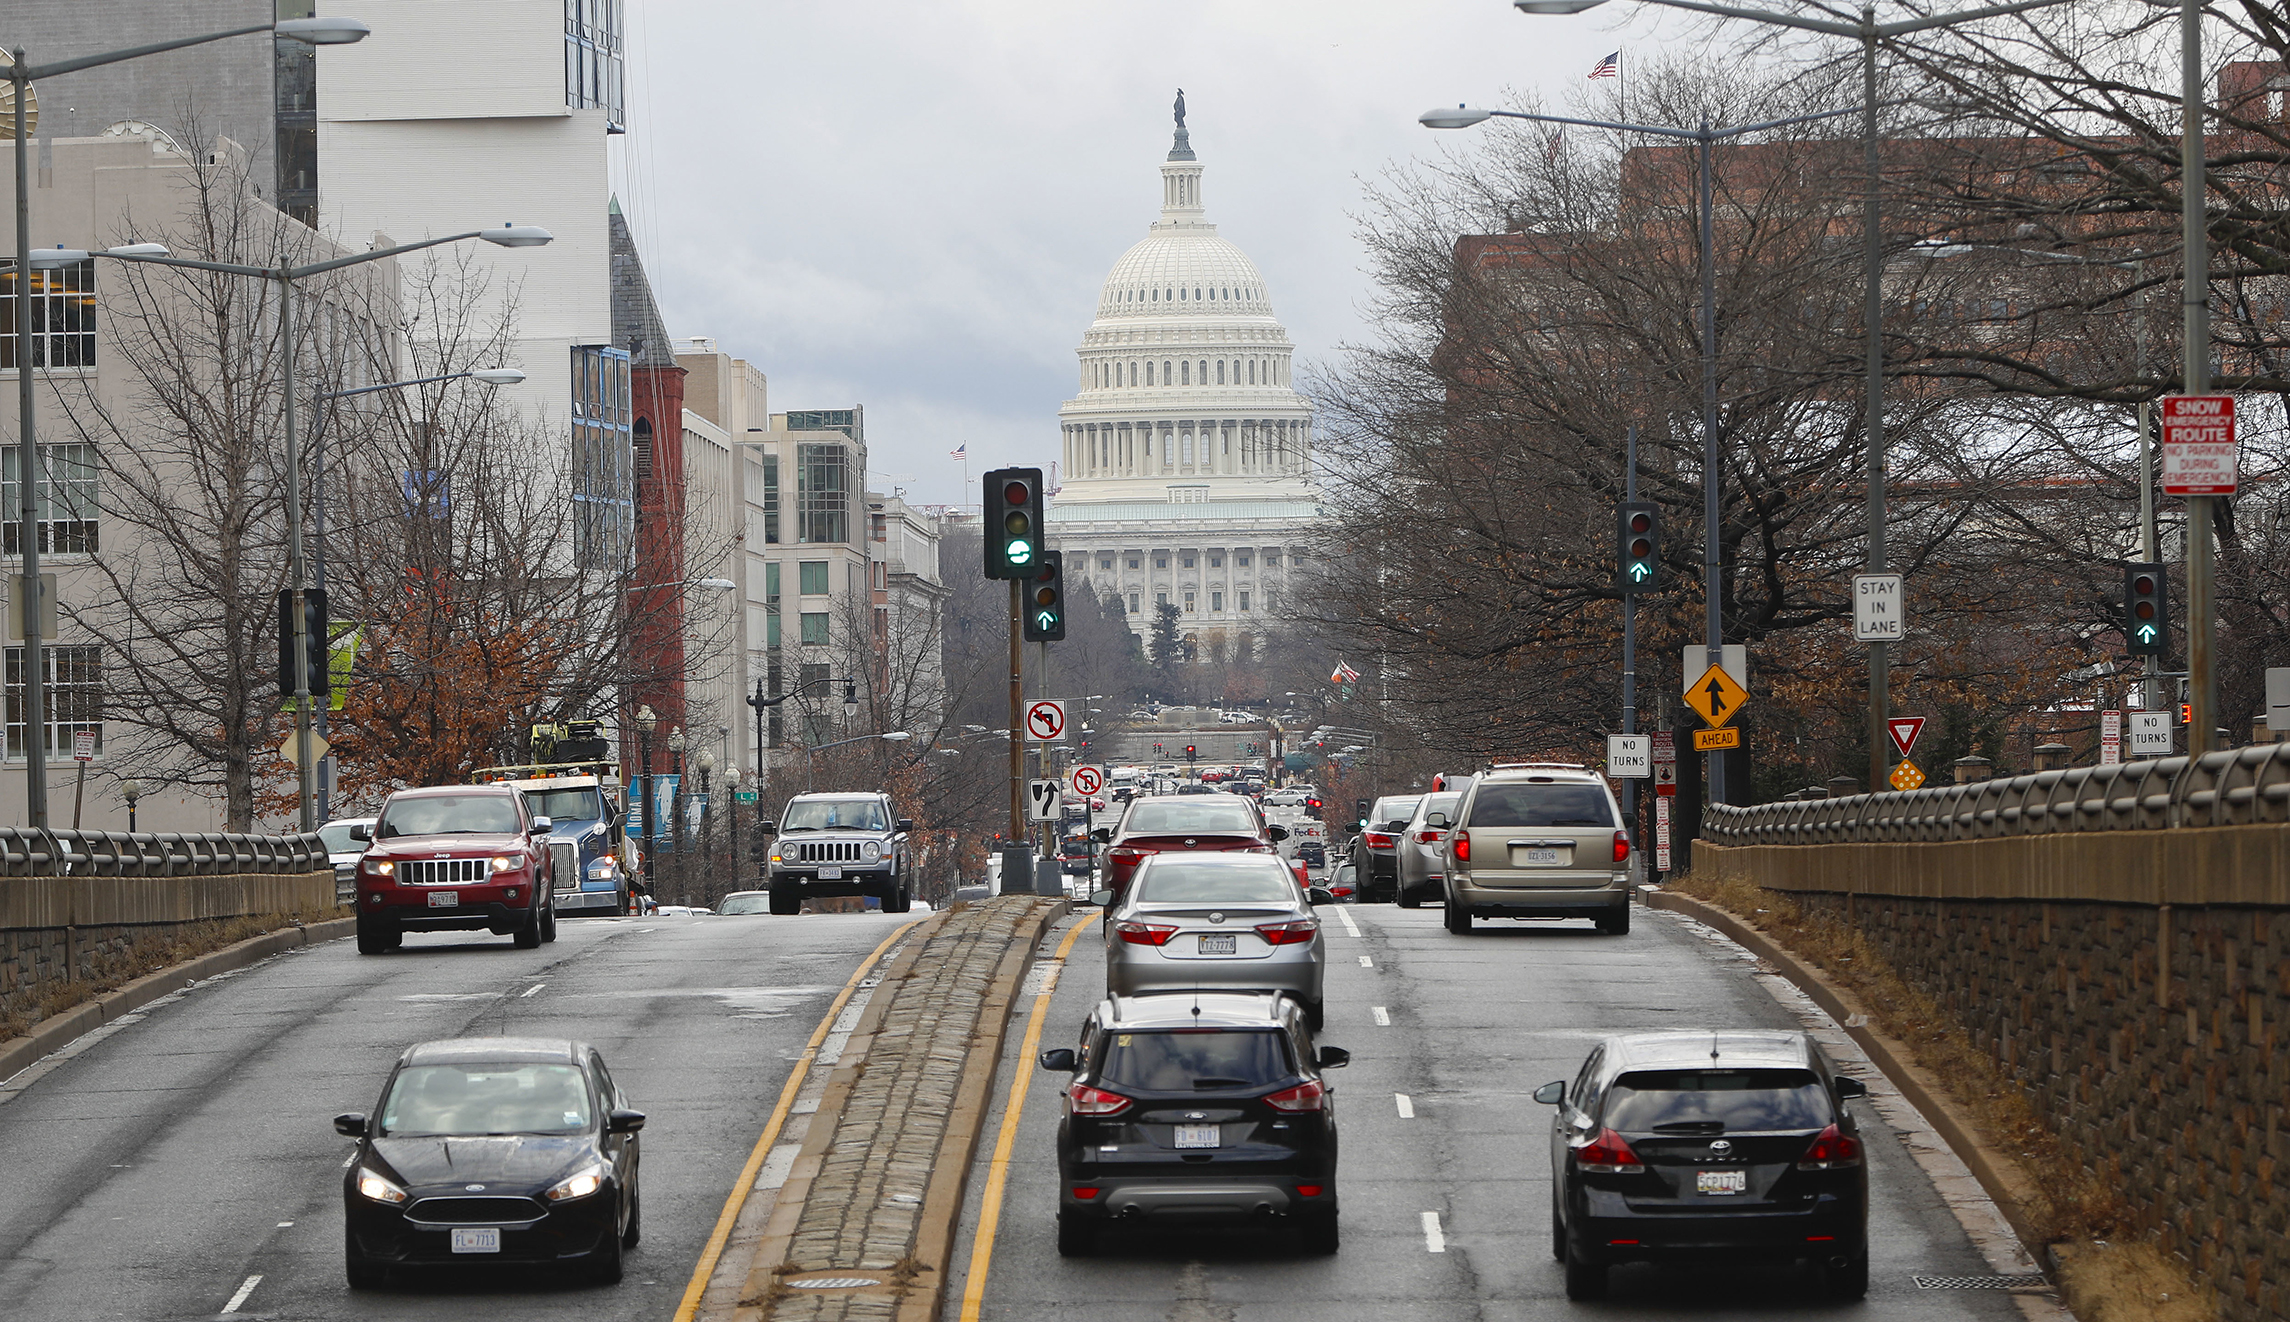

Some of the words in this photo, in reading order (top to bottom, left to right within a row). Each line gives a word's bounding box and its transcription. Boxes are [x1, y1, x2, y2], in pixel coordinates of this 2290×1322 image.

[2175, 401, 2222, 415] SNOW
[2166, 416, 2232, 427] EMERGENCY
[2171, 428, 2228, 442] ROUTE
[2167, 445, 2182, 456] NO
[2187, 445, 2231, 456] PARKING
[2180, 459, 2219, 470] DURING
[2167, 472, 2232, 483] EMERGENCY
[1861, 582, 1895, 594] STAY
[1872, 602, 1885, 613] IN
[1861, 621, 1897, 633] LANE
[2144, 718, 2157, 727] NO
[1701, 733, 1733, 746] AHEAD
[2135, 733, 2166, 743] TURNS
[1622, 741, 1636, 750] NO
[1614, 756, 1645, 766] TURNS
[627, 801, 642, 828] NOMA
[1294, 828, 1320, 836] FedEx
[455, 1234, 466, 1247] FL
[475, 1234, 495, 1246] 7713
